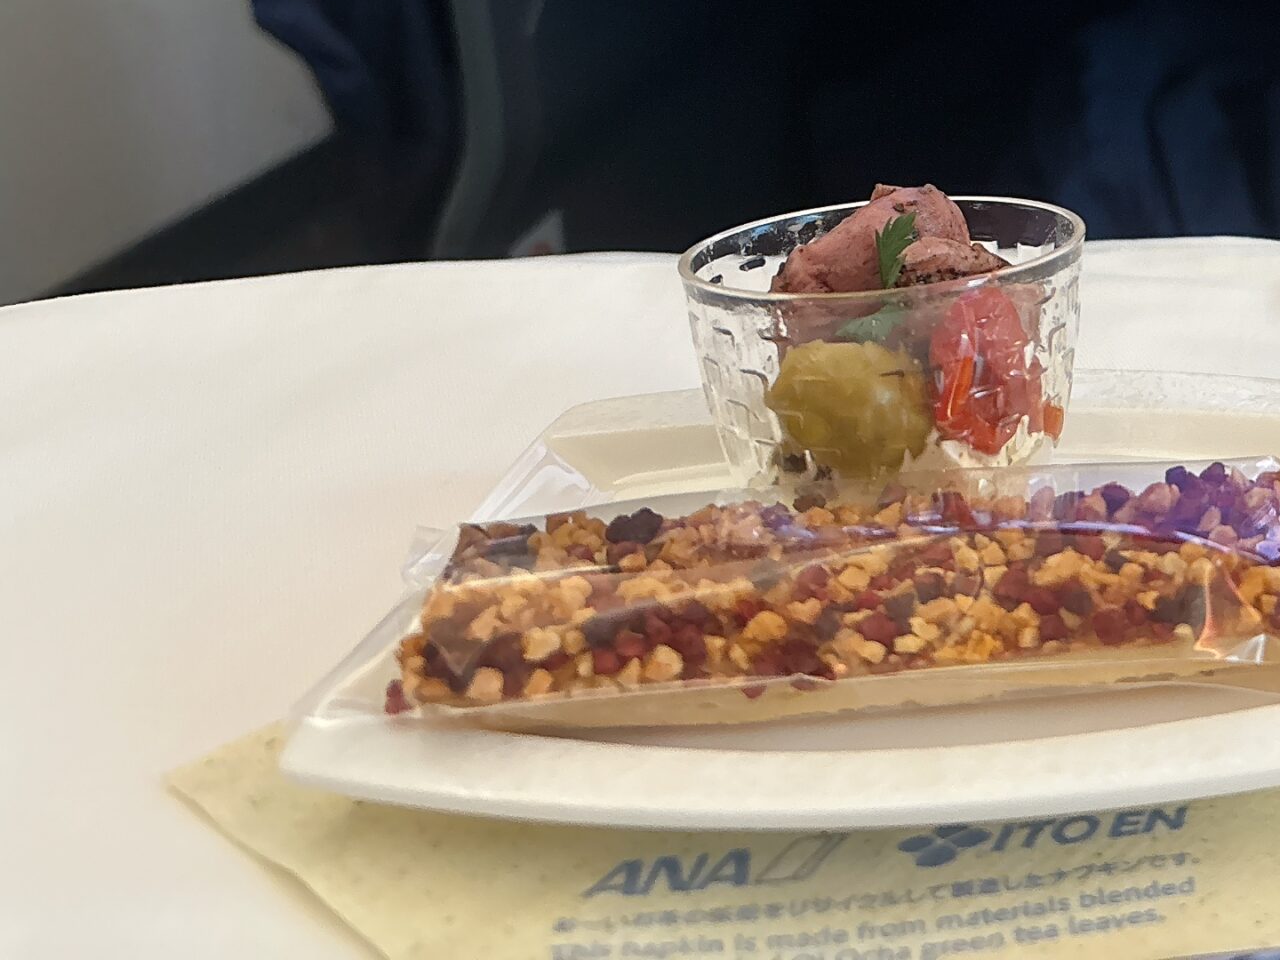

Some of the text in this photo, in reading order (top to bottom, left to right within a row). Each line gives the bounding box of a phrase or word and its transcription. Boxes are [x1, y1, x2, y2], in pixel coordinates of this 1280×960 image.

[990, 806, 1188, 852] ITO EN
[581, 847, 751, 899] ANA
[622, 936, 724, 959] napkin
[735, 933, 757, 952] is
[765, 925, 849, 949] made
[857, 918, 926, 942] from
[935, 895, 1072, 931] materials
[1079, 877, 1196, 910] blended
[921, 931, 1005, 960] green
[1013, 923, 1060, 945] tea
[1068, 907, 1167, 937] leaves.
